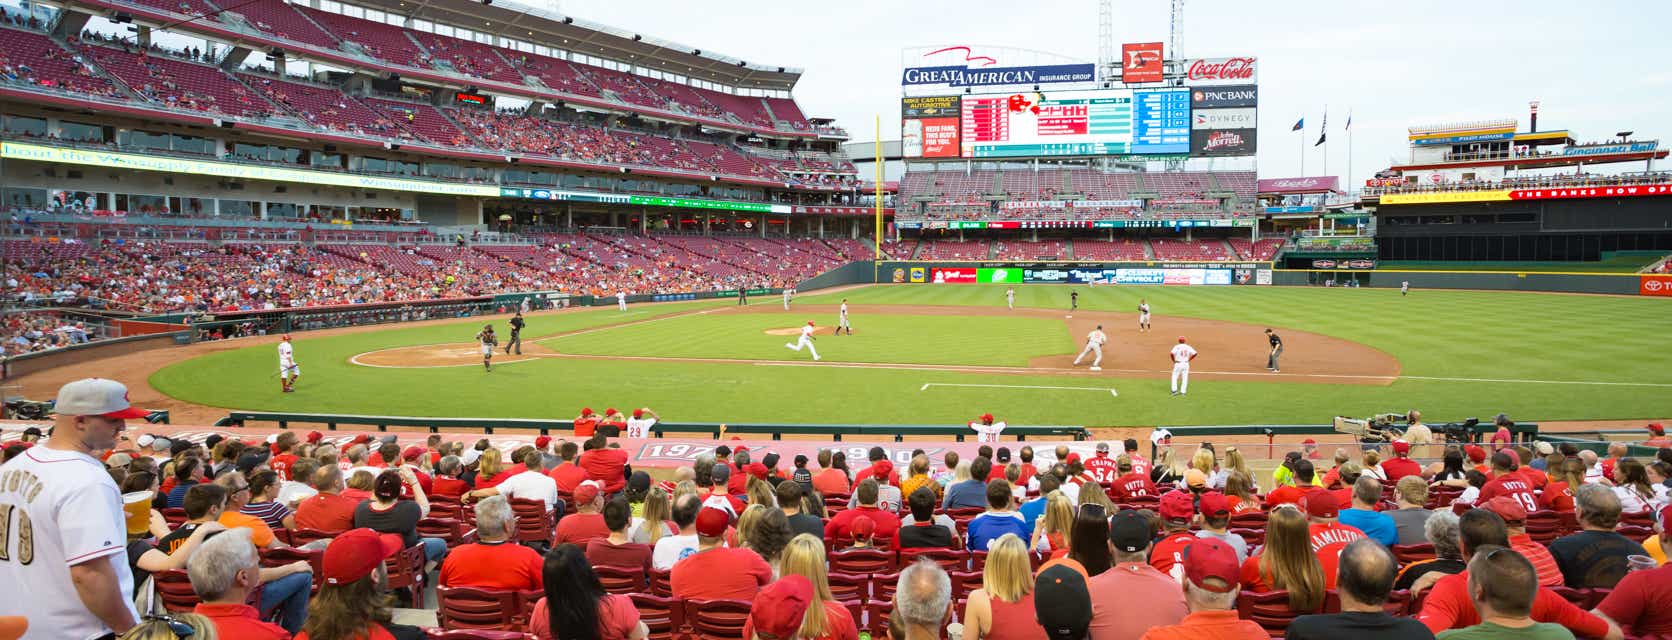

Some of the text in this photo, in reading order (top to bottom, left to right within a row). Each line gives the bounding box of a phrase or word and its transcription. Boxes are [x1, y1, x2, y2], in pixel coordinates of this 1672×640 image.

[1039, 74, 1073, 82] INSURANCE
[1074, 73, 1092, 81] GROUP
[1209, 115, 1250, 123] DYNEGY
[1565, 143, 1656, 156] Cincinnati Bell
[629, 427, 641, 438] 29
[1095, 467, 1115, 483] 54
[1511, 492, 1537, 513] 19
